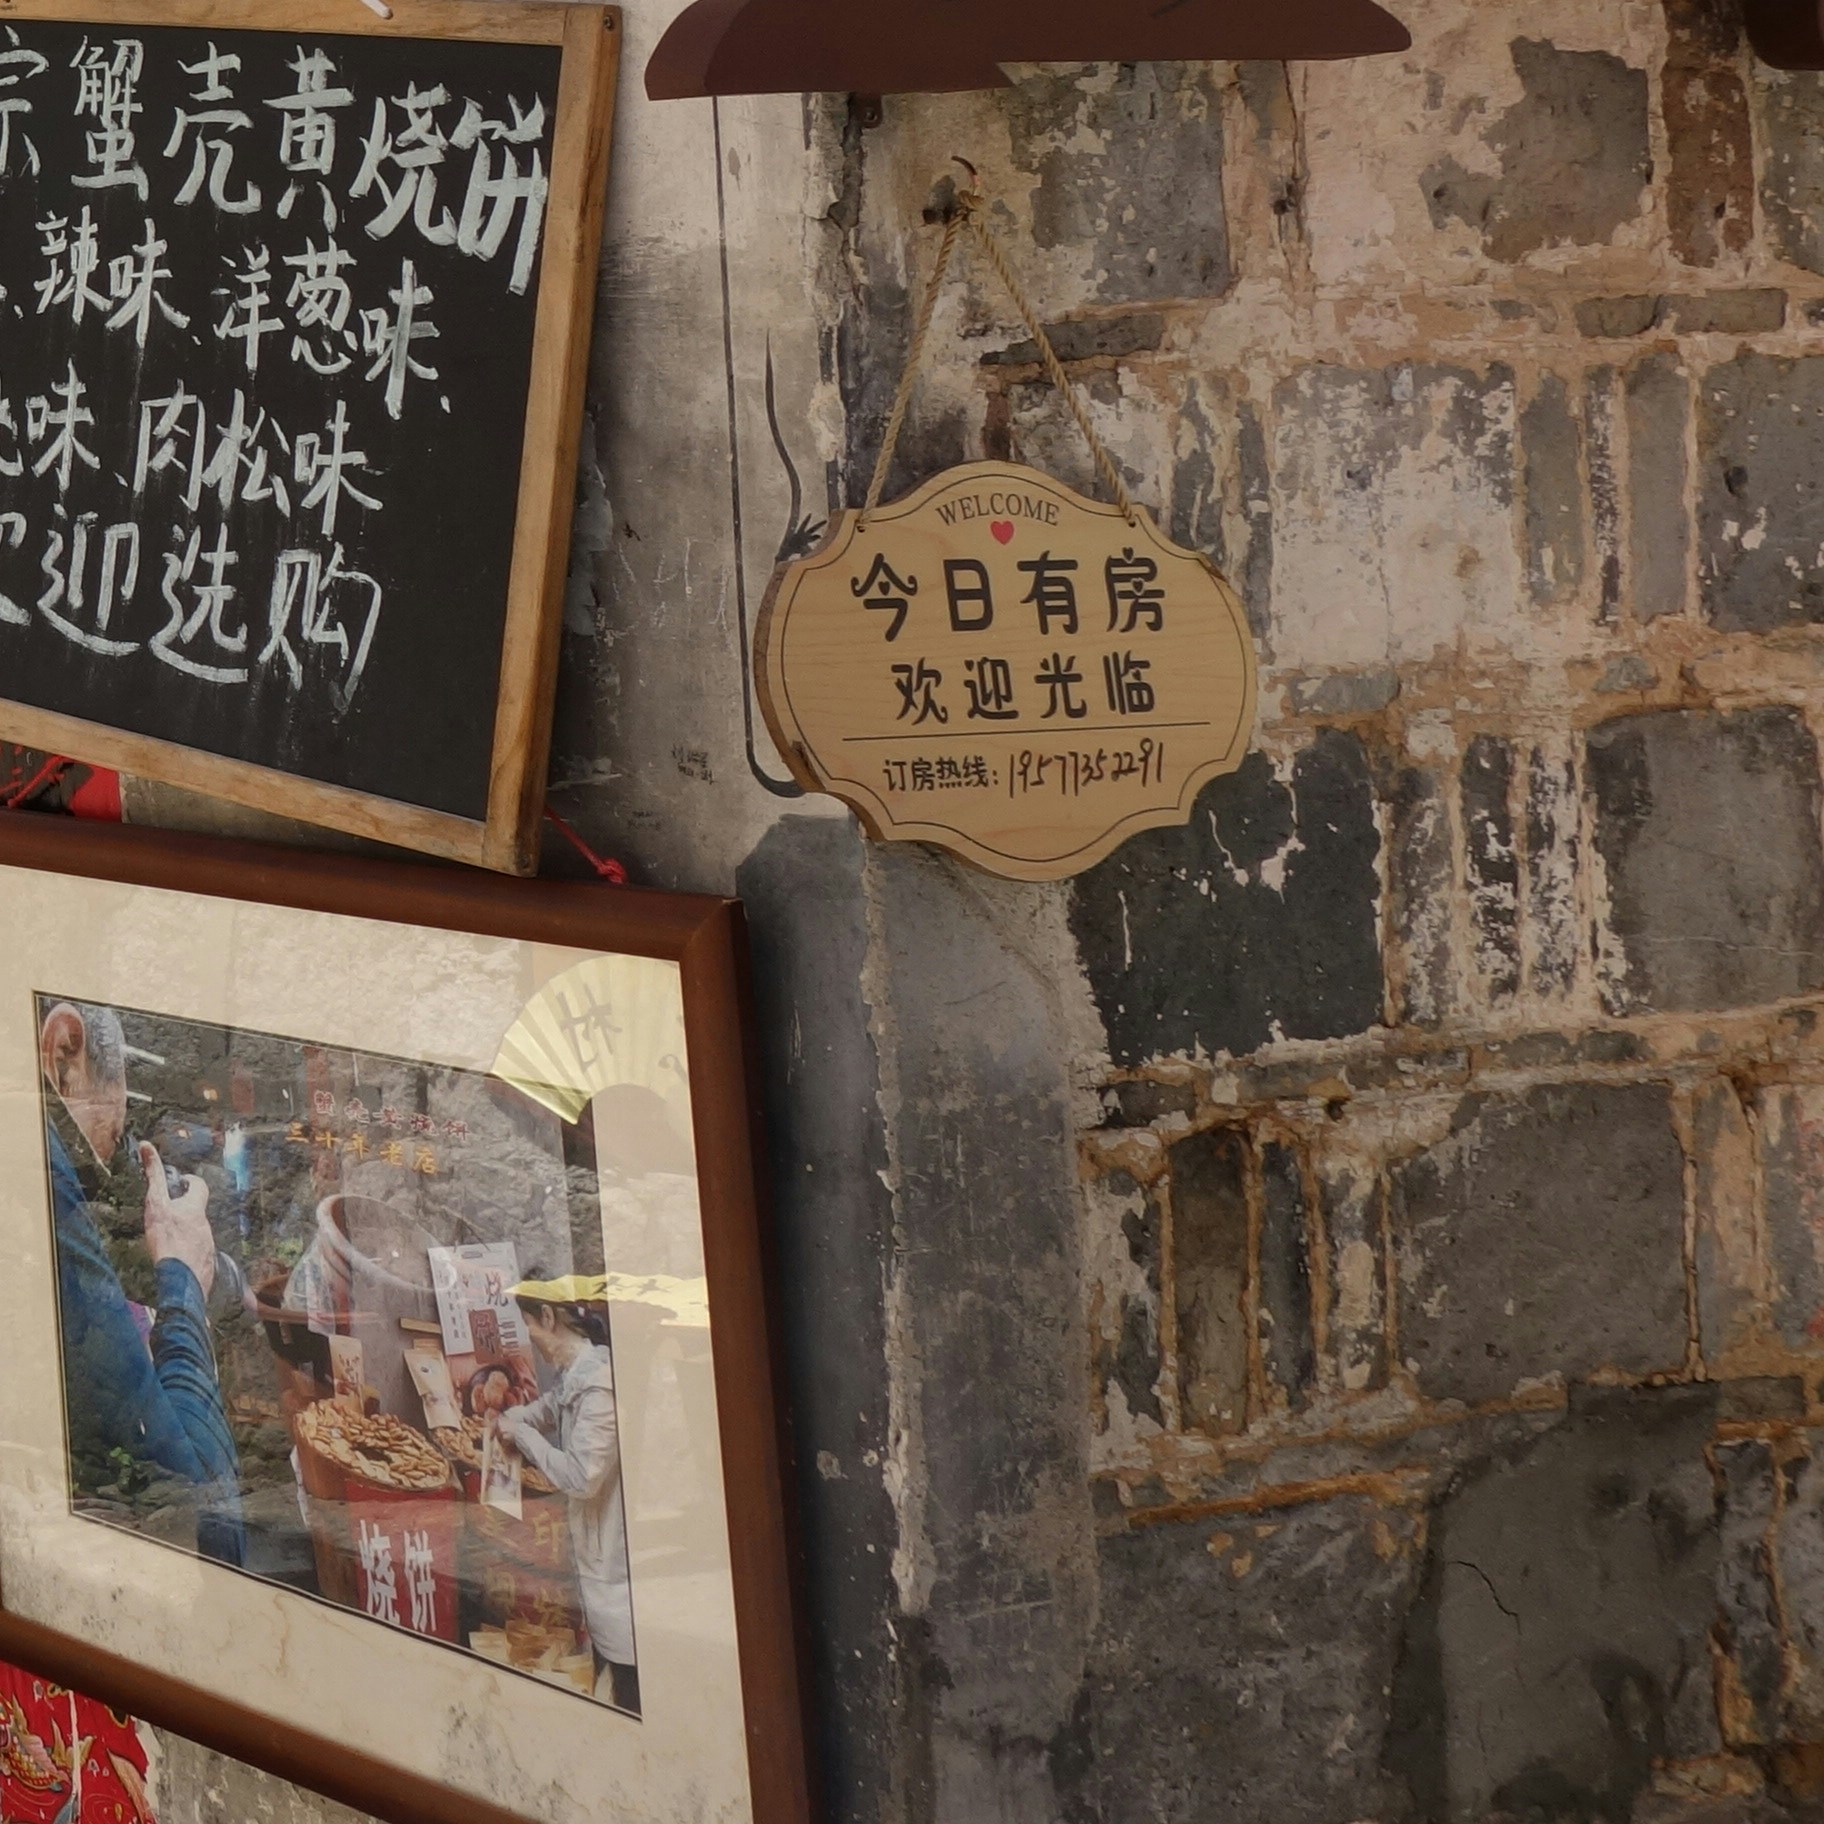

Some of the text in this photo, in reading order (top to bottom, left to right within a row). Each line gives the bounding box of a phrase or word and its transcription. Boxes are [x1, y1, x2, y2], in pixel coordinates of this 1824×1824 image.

[935, 491, 1061, 528] WELCOME
[850, 546, 1166, 643] 今日有房
[890, 650, 1155, 726] 欢迎光临
[285, 1121, 440, 1176] 三十年老店
[357, 1519, 436, 1635] 烧饼
